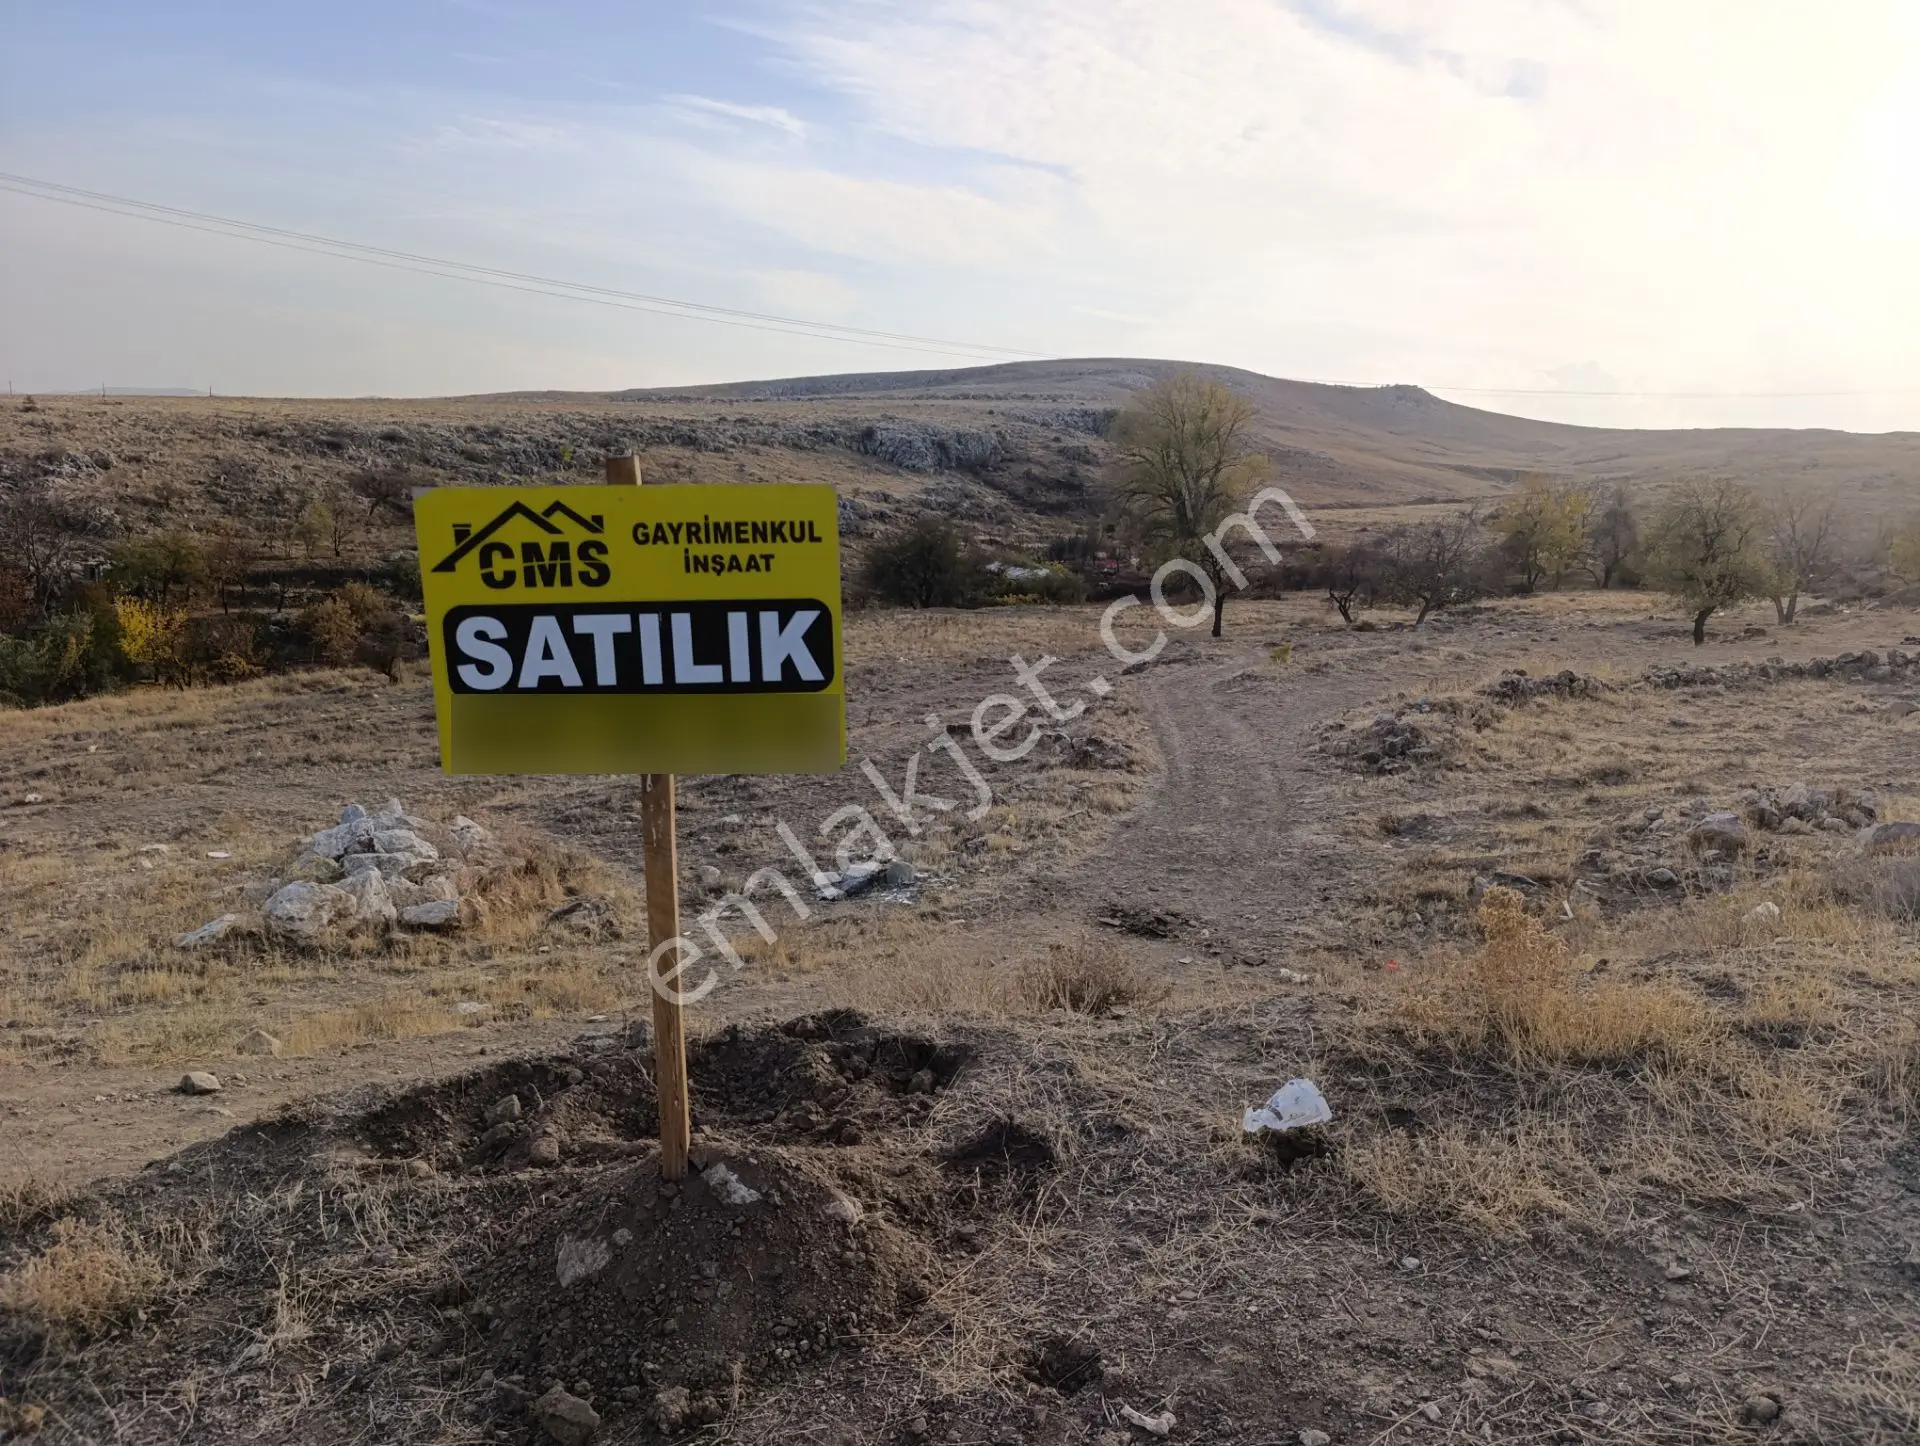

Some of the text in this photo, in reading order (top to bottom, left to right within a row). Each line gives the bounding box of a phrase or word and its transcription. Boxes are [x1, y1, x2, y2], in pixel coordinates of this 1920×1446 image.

[632, 514, 822, 546] GAYRİMENKUL
[478, 540, 611, 589] CMS
[684, 548, 775, 576] İNŞAAT
[455, 610, 825, 690] SATILIK
